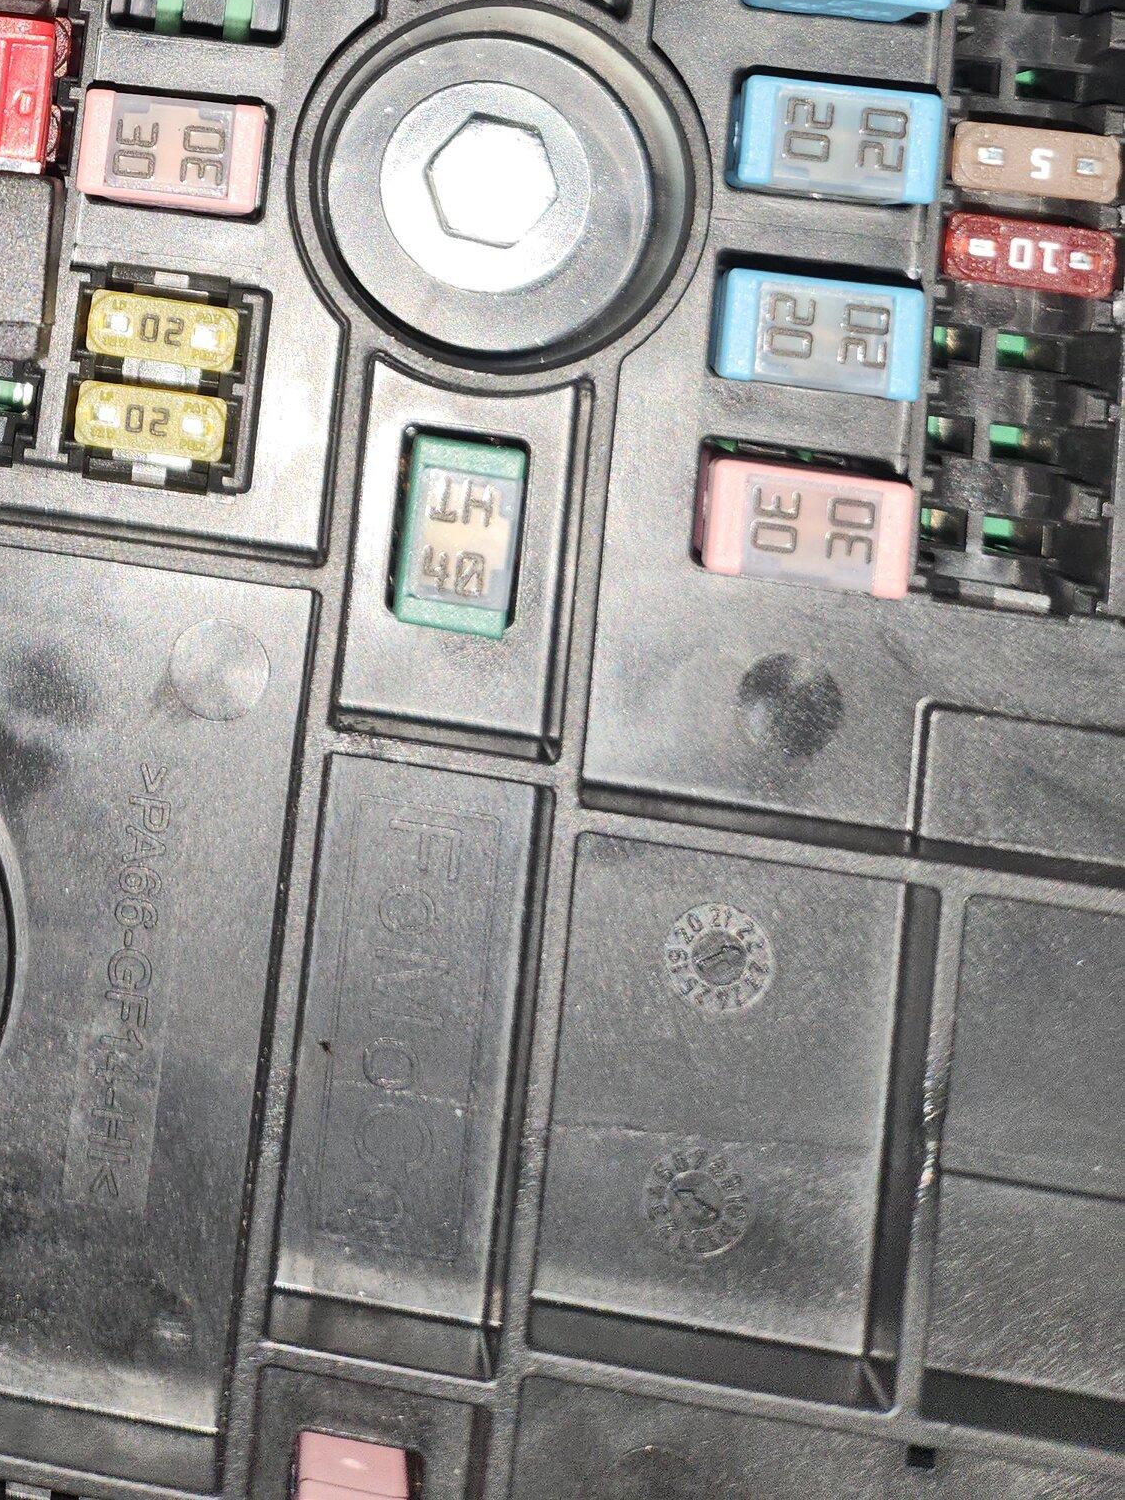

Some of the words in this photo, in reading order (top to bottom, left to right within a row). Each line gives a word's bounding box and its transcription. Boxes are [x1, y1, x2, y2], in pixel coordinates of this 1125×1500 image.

[112, 119, 159, 179] 30
[180, 124, 226, 186] 30
[783, 97, 835, 163] 20
[856, 107, 909, 172] 20
[1030, 148, 1055, 180] 5
[1009, 237, 1062, 274] 10
[140, 313, 185, 347] 20
[765, 292, 816, 360] 20
[837, 303, 891, 370] 20
[125, 403, 170, 437] 20
[750, 485, 801, 554] 30
[825, 497, 876, 564] 30
[422, 543, 485, 597] 40
